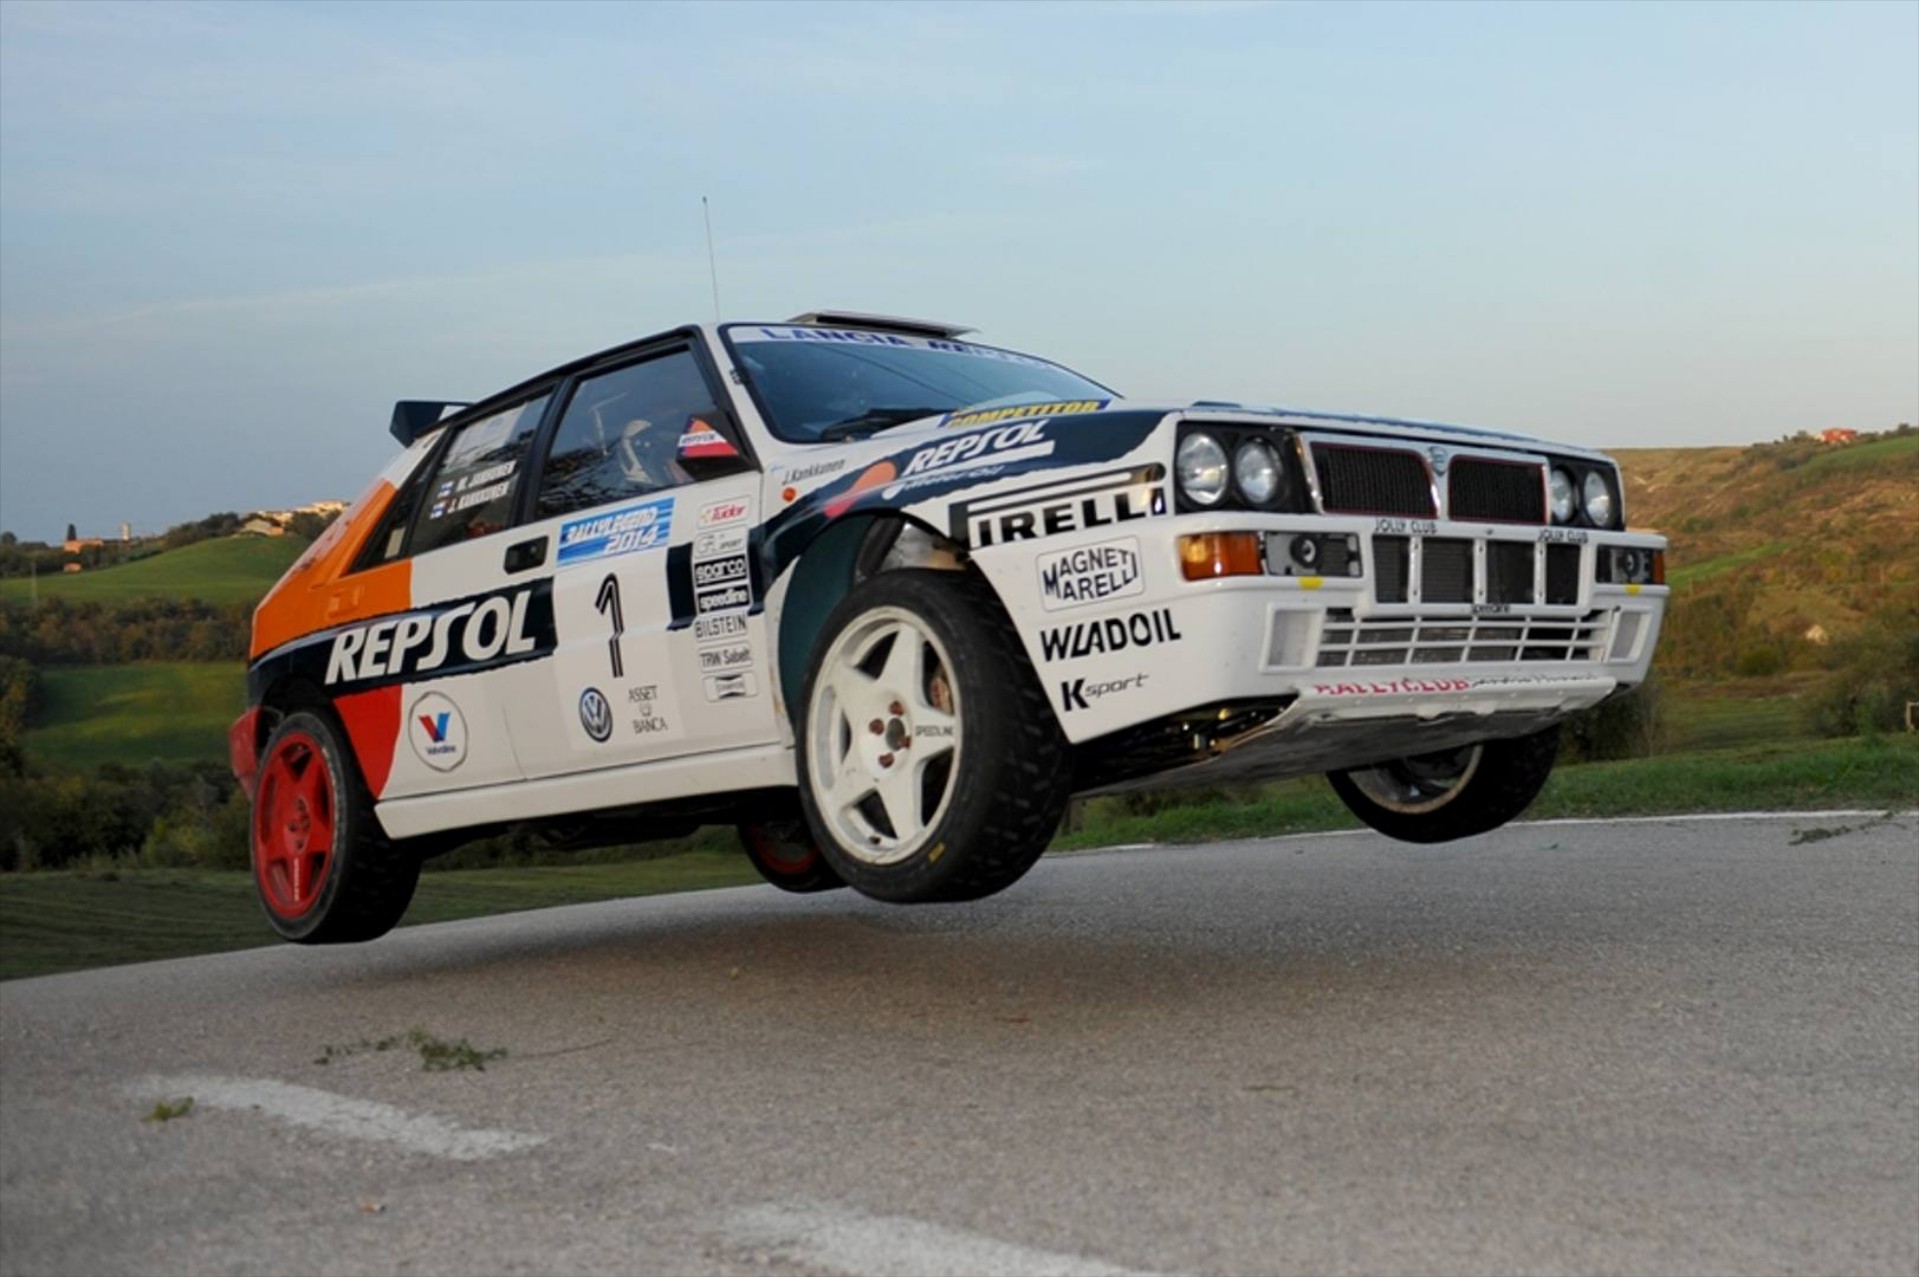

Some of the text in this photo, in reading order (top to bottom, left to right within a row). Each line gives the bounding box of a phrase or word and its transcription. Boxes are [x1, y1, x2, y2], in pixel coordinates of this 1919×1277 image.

[760, 328, 911, 346] LANCIA
[948, 400, 1102, 428] COMPETITOR
[901, 419, 1050, 478] REPSOL
[604, 525, 660, 554] 2014
[695, 557, 746, 585] sparco
[324, 590, 537, 686] REPSOL
[594, 572, 625, 679] 1
[694, 613, 748, 639] BILSTEIN
[1040, 608, 1182, 662] WLADOIL
[628, 684, 658, 703] ASSET
[632, 717, 669, 734] BANCA
